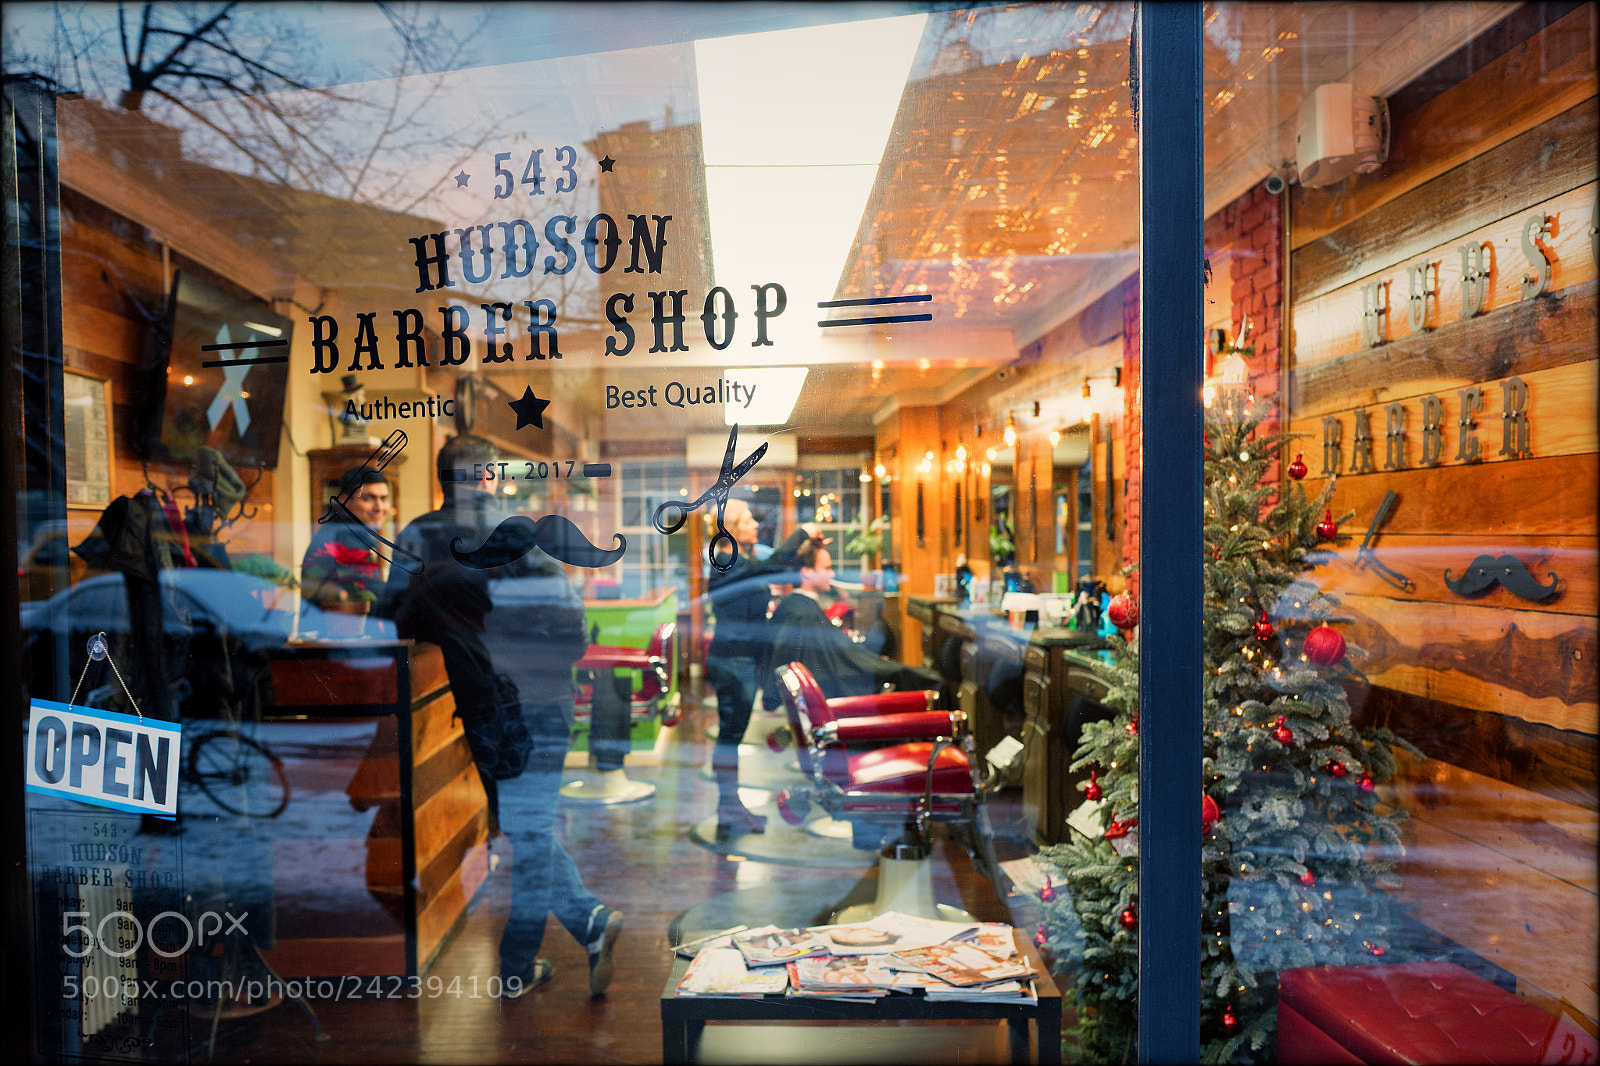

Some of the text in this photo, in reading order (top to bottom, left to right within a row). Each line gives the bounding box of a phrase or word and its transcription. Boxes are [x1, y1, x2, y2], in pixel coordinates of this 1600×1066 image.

[493, 144, 579, 199] 543
[408, 212, 673, 293] HUDSON
[308, 282, 788, 375] BARBER SHOP
[344, 394, 455, 422] Authentic
[605, 379, 757, 410] Best Quality
[1320, 376, 1534, 476] BARBER
[473, 460, 576, 482] EST. 2017
[34, 715, 171, 805] OPEN
[93, 822, 117, 838] 543
[70, 843, 143, 865] HUDSON
[41, 864, 173, 890] BARBER SHOP
